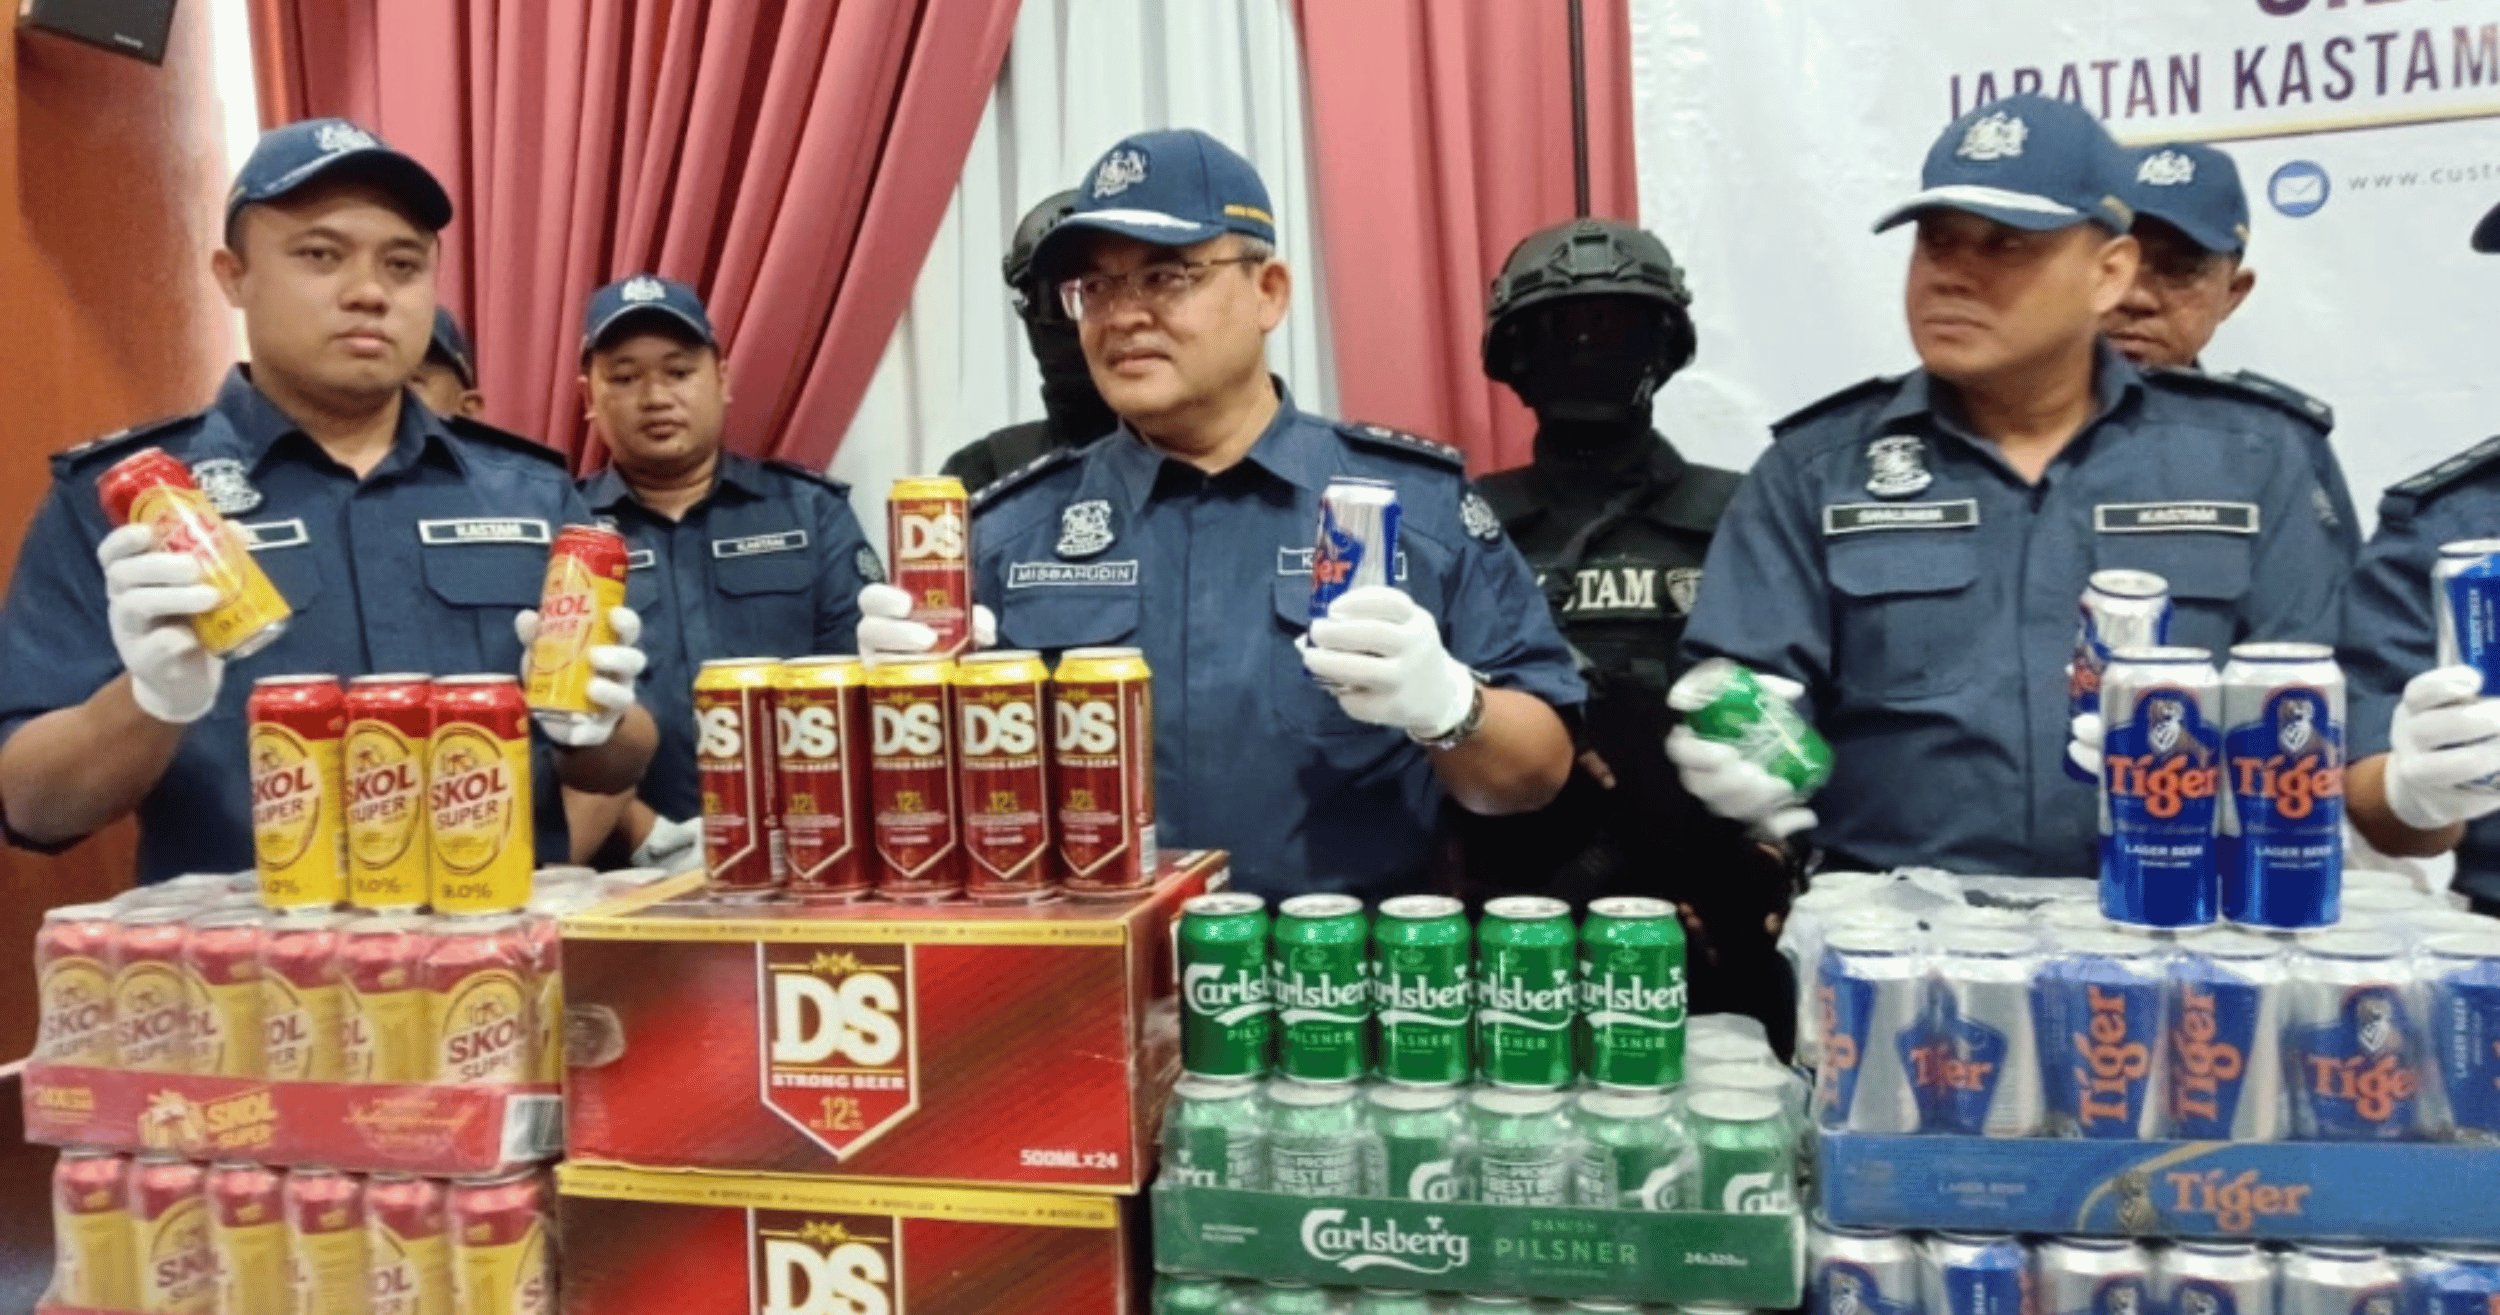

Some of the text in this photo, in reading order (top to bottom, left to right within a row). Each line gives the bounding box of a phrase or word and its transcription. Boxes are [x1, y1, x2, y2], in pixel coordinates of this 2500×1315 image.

[2234, 22, 2500, 110] KASTAM
[900, 513, 964, 559] DS
[1017, 566, 1130, 581] MISBAHUDIN
[872, 702, 944, 756] DS
[964, 701, 1037, 754] DS
[1056, 701, 1117, 754] DS
[430, 766, 508, 812] SKOL
[2107, 754, 2219, 817] Tiger
[436, 799, 500, 830] SUPER
[447, 1018, 518, 1065] SKO
[772, 972, 902, 1066] DS
[2073, 984, 2149, 1126] Tiger
[771, 1074, 905, 1090] STRONG BEER
[2307, 1054, 2420, 1122] Tige
[2166, 1168, 2312, 1231] Tiger
[1302, 1208, 1470, 1267] Carlsberg
[1495, 1236, 1638, 1264] PILSNER
[764, 1239, 888, 1315] DS
